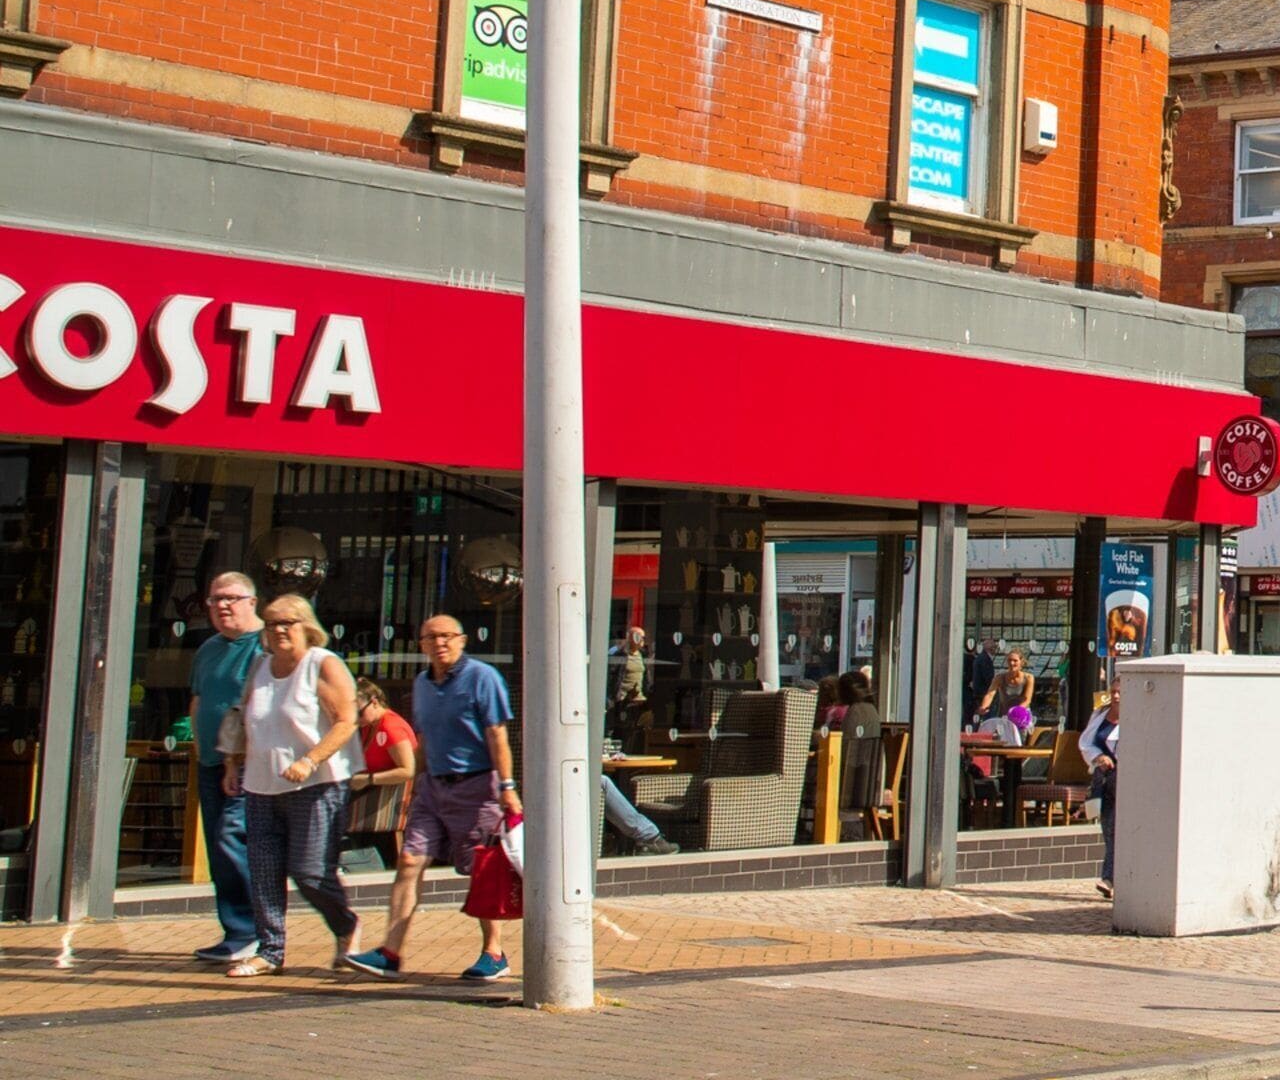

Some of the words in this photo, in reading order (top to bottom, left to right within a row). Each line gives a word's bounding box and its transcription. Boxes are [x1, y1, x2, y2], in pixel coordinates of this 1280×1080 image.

[911, 94, 965, 121] SCAPE
[910, 118, 963, 145] OOM
[910, 140, 963, 168] ENTRE
[1226, 423, 1267, 444] COSTA
[1221, 462, 1270, 488] COFFEE
[1257, 583, 1271, 591] OFF
[1115, 641, 1138, 652] COSTA
